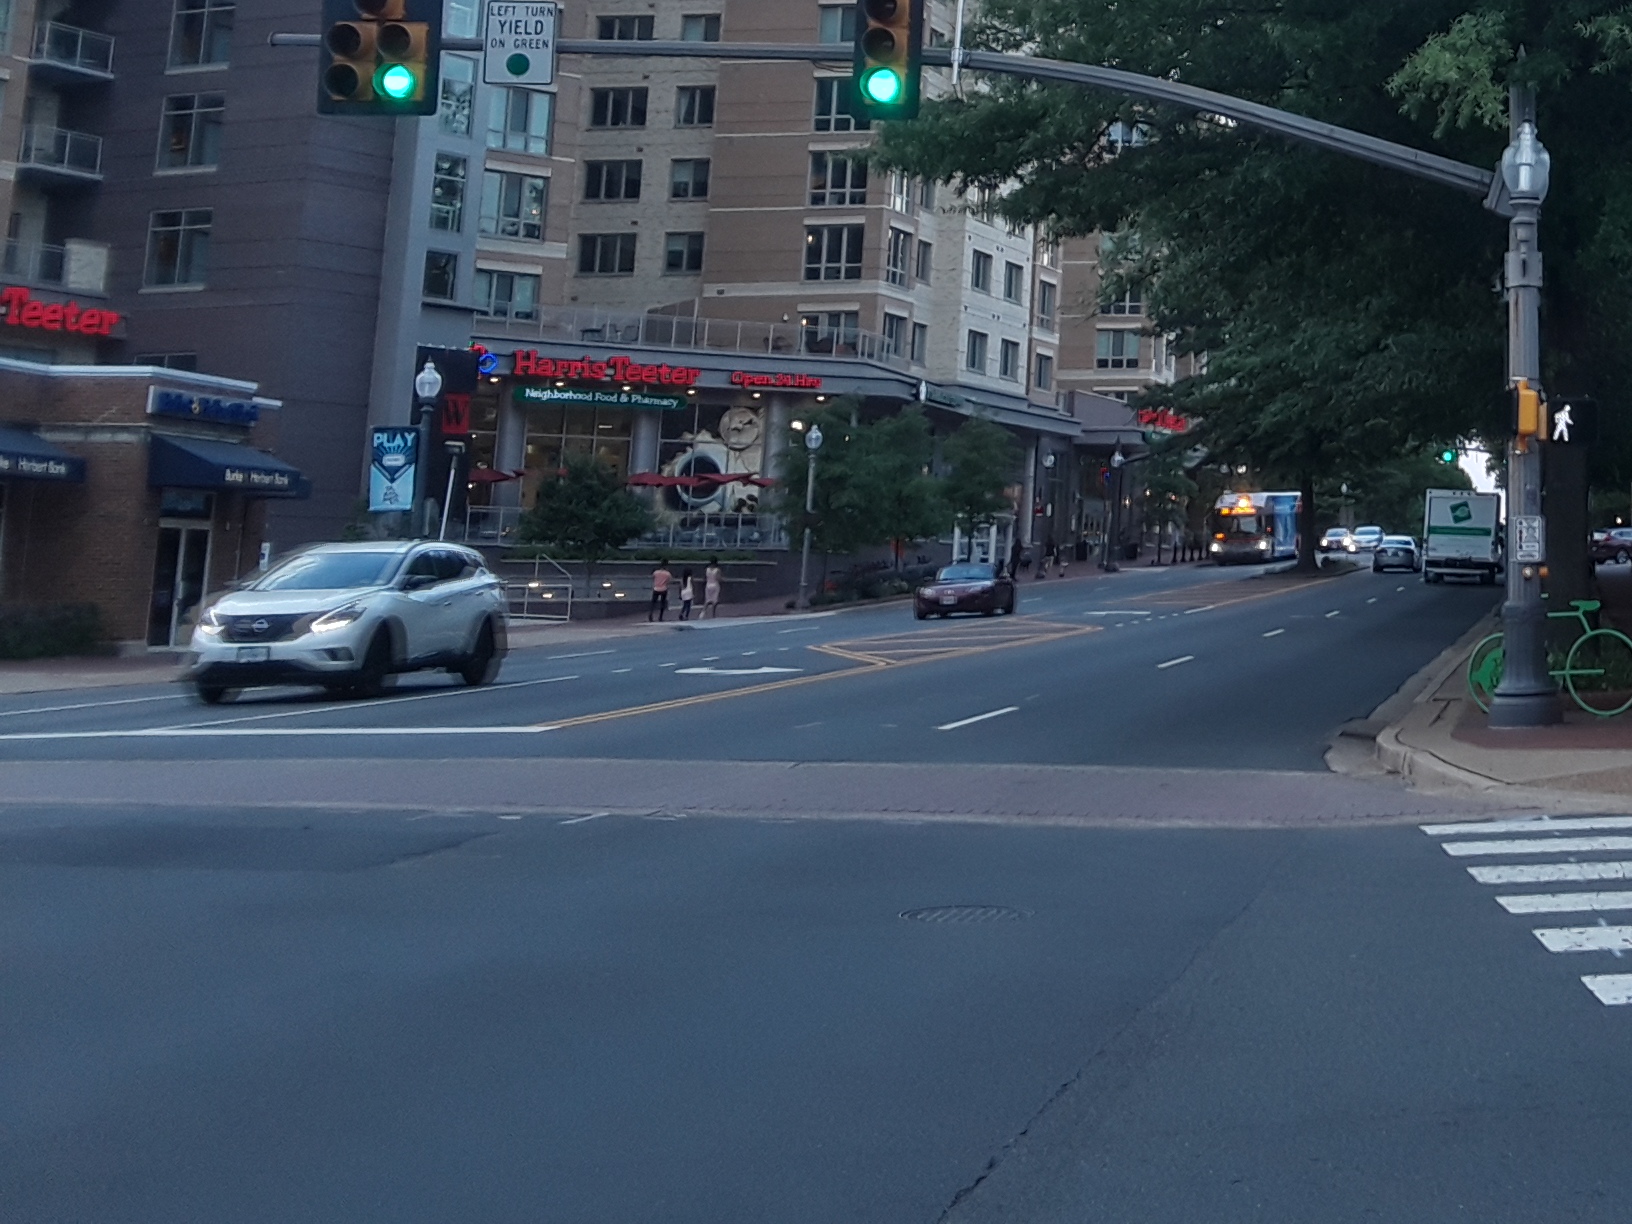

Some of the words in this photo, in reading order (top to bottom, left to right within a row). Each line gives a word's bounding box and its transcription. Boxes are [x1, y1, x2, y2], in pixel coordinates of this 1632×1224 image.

[490, 5, 517, 17] LEFT
[525, 5, 554, 17] TURN
[498, 19, 544, 36] YIELD
[490, 37, 505, 49] ON
[513, 37, 550, 50] GREEN
[1, 286, 120, 336] Teeter
[513, 349, 606, 379] Harris
[608, 355, 702, 386] Teeter
[731, 371, 772, 388] Open
[525, 387, 593, 402] Neighborhood
[594, 391, 617, 403] Food
[619, 392, 630, 403] &
[631, 394, 679, 408] Pharmacy
[373, 431, 416, 448] PLAY
[225, 468, 243, 482] Burke
